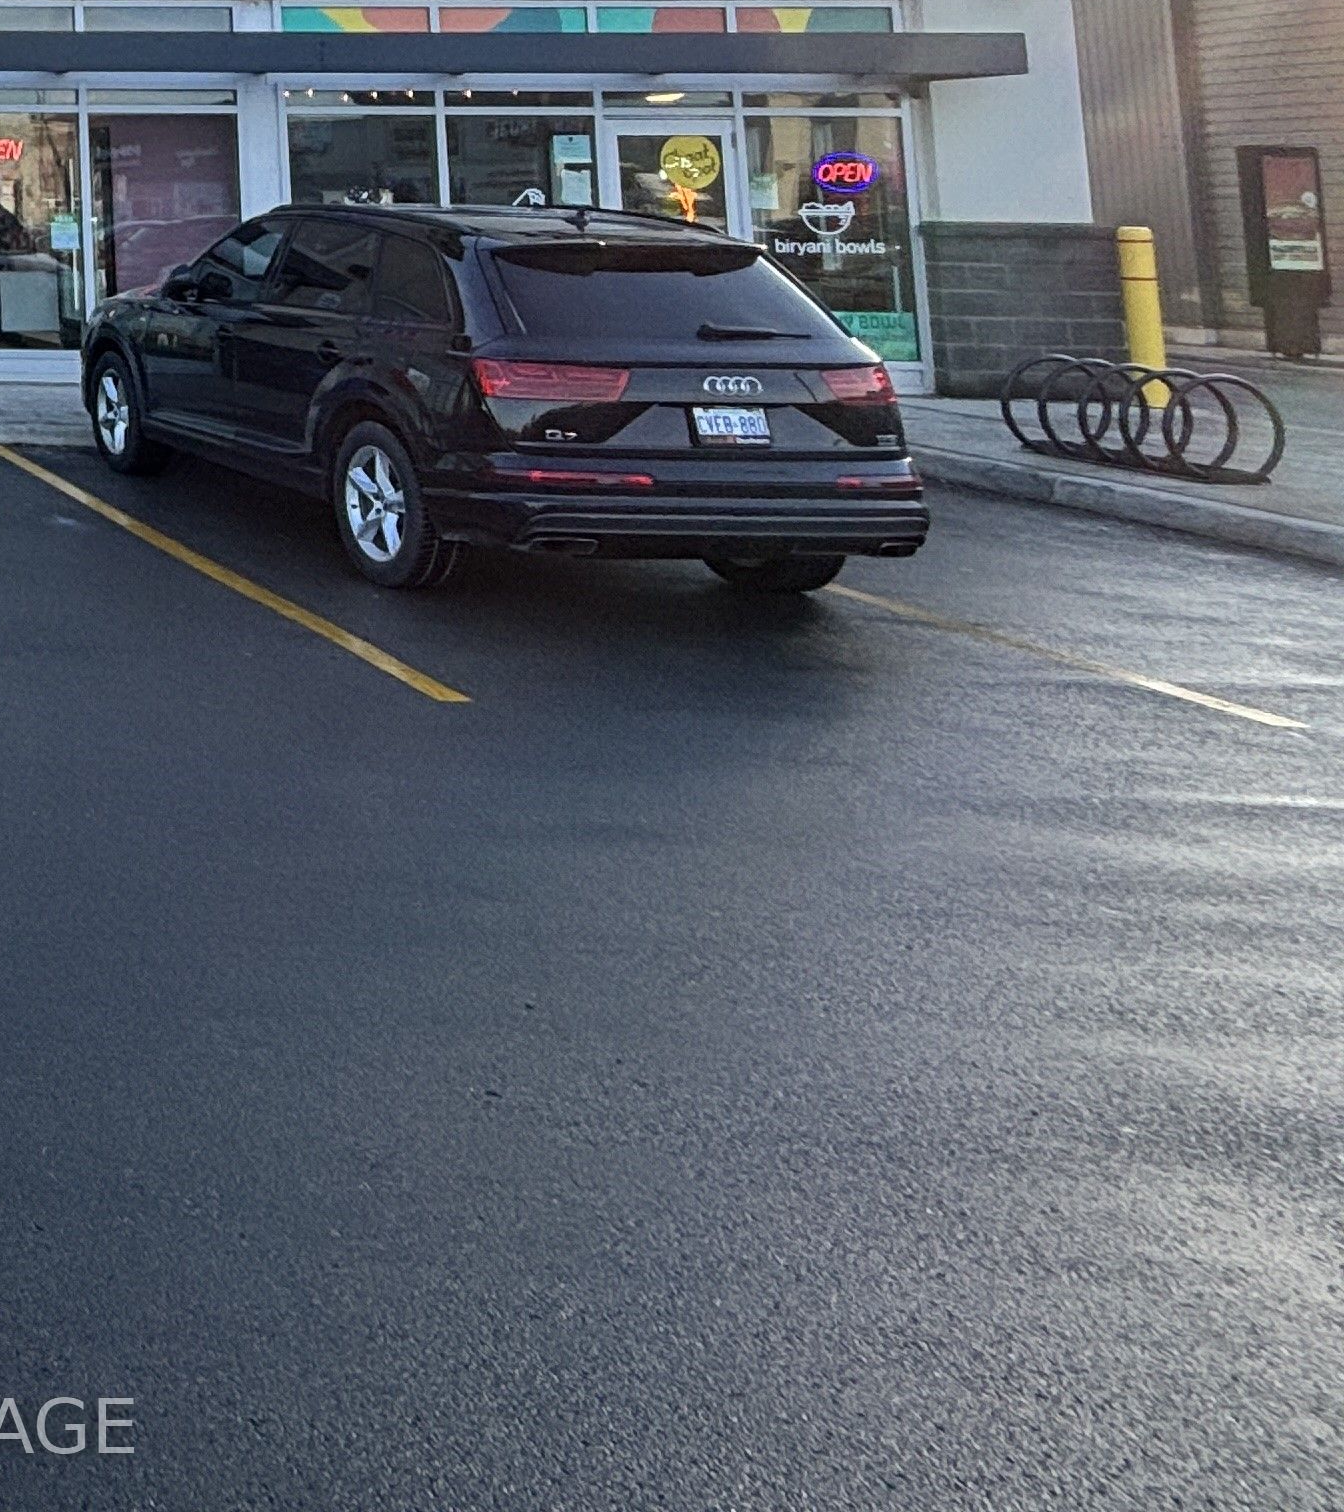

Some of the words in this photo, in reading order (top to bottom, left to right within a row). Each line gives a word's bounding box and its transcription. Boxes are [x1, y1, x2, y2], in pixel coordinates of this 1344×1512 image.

[818, 162, 873, 183] OPEN
[774, 239, 831, 256] biryani
[835, 239, 886, 254] bowls
